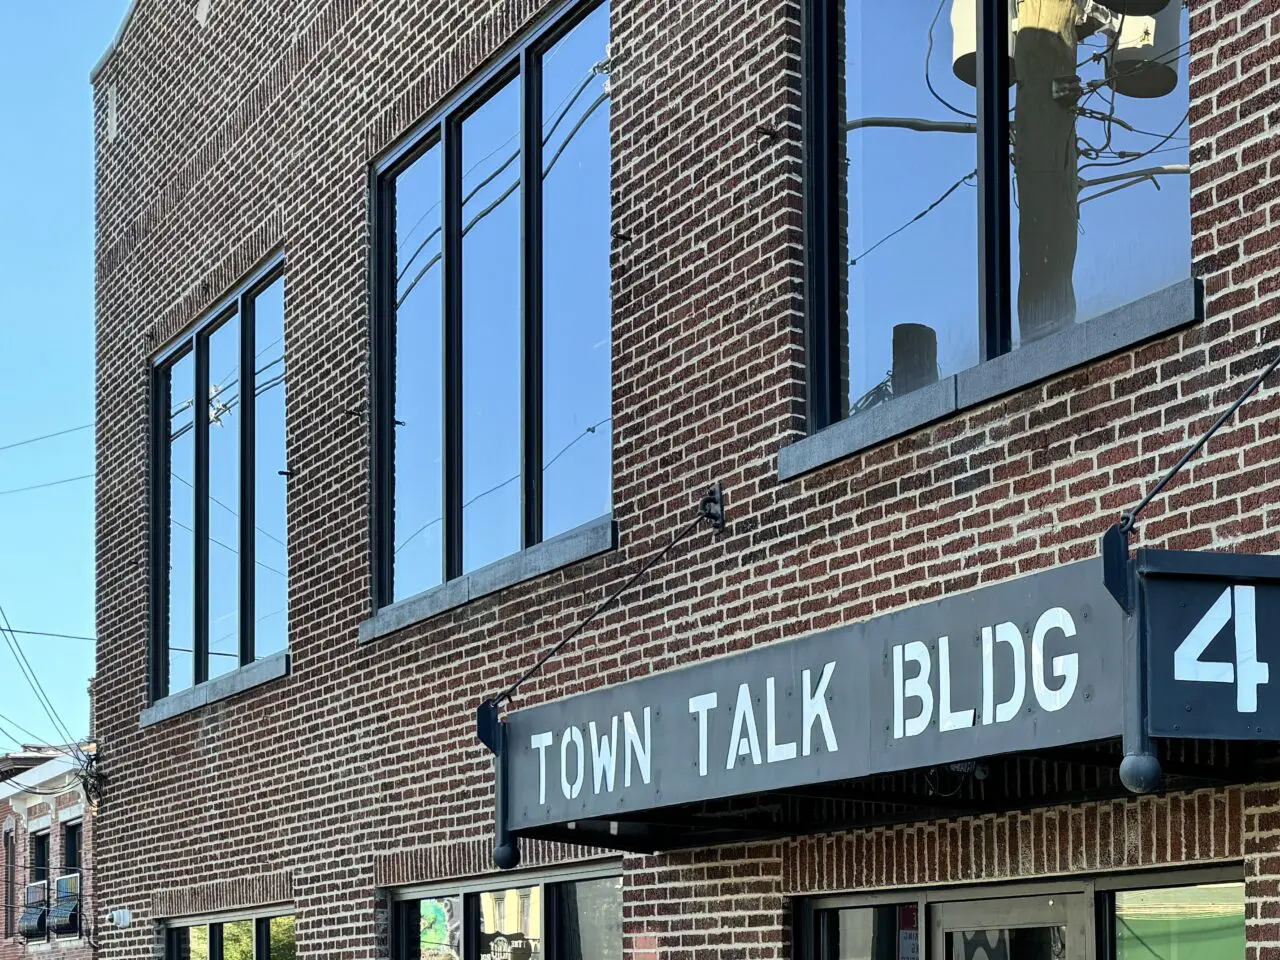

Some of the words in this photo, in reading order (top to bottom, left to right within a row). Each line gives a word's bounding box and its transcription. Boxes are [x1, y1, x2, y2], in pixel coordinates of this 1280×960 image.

[531, 706, 651, 804] TOWN
[688, 661, 839, 777] TALK
[892, 606, 1079, 739] BLDG
